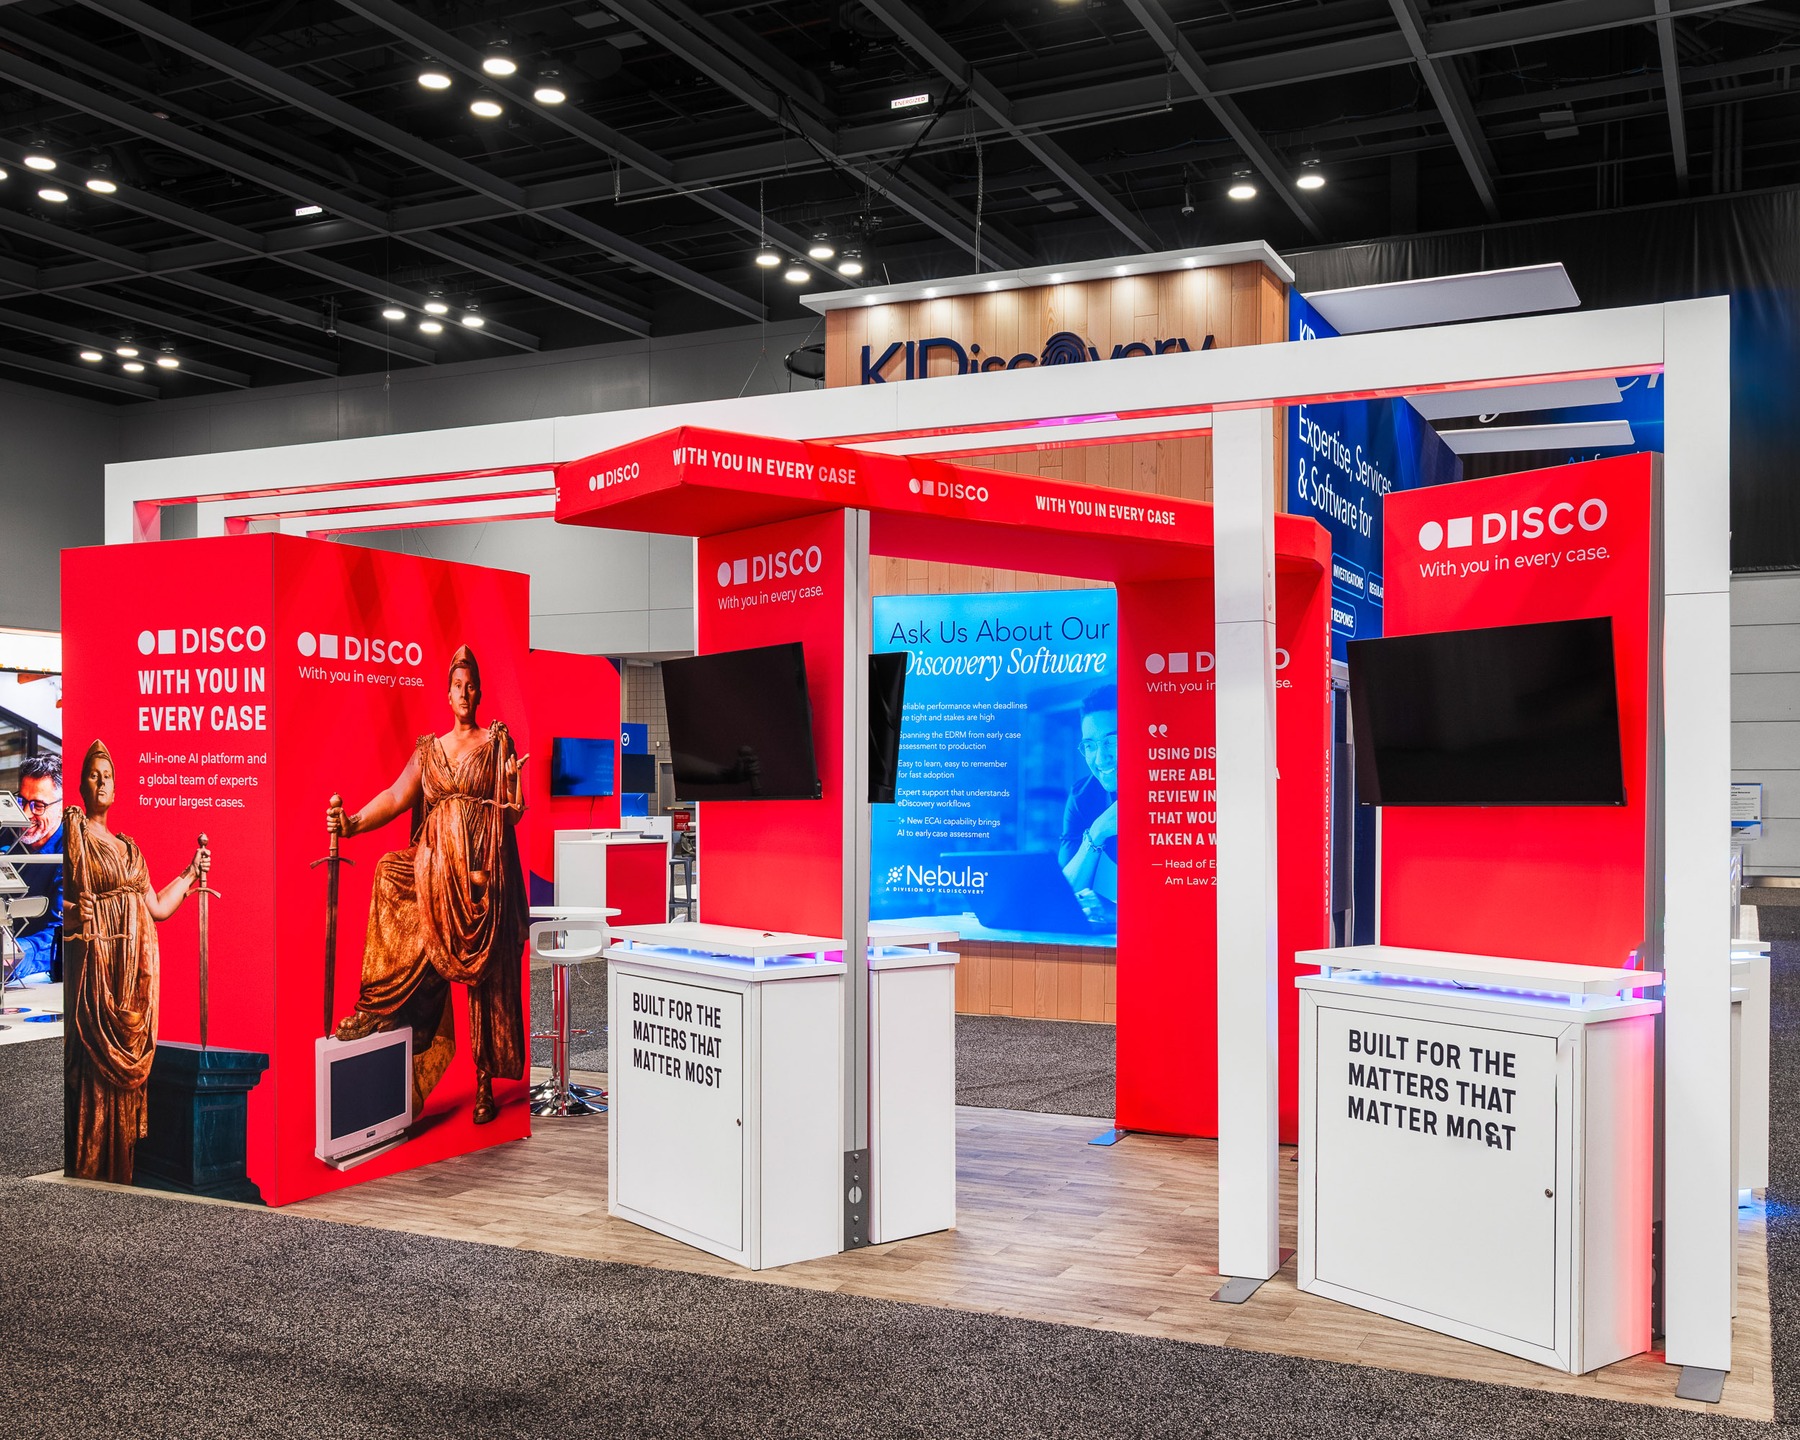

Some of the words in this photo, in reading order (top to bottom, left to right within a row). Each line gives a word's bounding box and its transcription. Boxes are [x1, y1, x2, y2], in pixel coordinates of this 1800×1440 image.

[1299, 404, 1353, 482] Expertise,
[1355, 445, 1392, 496] Services
[606, 462, 639, 487] DISCO
[672, 447, 708, 466] WITH
[711, 451, 743, 471] YOU
[747, 456, 762, 474] IN
[766, 459, 814, 480] EVERY
[818, 466, 856, 485] CASE
[937, 482, 989, 503] DISCO
[1298, 457, 1308, 501] &
[1311, 466, 1357, 530] Software
[1359, 496, 1372, 539] for
[1035, 495, 1066, 514] WITH
[1068, 499, 1092, 516] YOU
[1094, 502, 1107, 517] IN
[1109, 504, 1145, 522] EVERY
[1147, 509, 1176, 526] CASE
[1482, 498, 1608, 544] DISCO
[752, 545, 822, 582] DISCO
[1419, 560, 1456, 578] With
[1460, 560, 1490, 578] you
[1494, 554, 1510, 571] in
[1514, 551, 1562, 568] every
[1566, 546, 1611, 563] case.
[1333, 564, 1364, 590] INVESTIGATIONS
[718, 595, 739, 610] With
[741, 595, 758, 610] you
[760, 591, 769, 604] in
[770, 589, 797, 603] every
[799, 585, 824, 598] case.
[1334, 609, 1354, 628] RESPONSE
[182, 625, 266, 654] DISCO
[889, 620, 931, 644] Ask
[940, 621, 968, 644] Us
[976, 618, 1053, 643] About
[1061, 616, 1110, 640] Our
[345, 635, 423, 666] DISCO
[1007, 646, 1107, 674] Software
[138, 669, 190, 695] WITH
[195, 668, 238, 694] YOU
[244, 667, 265, 693] IN
[298, 665, 327, 680] With
[329, 671, 350, 683] you
[353, 670, 364, 683] in
[366, 674, 396, 687] every
[398, 676, 424, 687] case.
[1146, 681, 1177, 693] With
[1179, 682, 1203, 694] you
[1276, 679, 1293, 689] se.
[902, 702, 925, 710] eliable
[927, 702, 971, 711] performance
[972, 702, 991, 710] when
[993, 701, 1028, 710] deadlines
[139, 706, 205, 731] EVERY
[210, 705, 267, 731] CASE
[911, 714, 927, 723] tight
[928, 713, 942, 721] and
[943, 713, 965, 721] stakes
[979, 713, 995, 723] high
[899, 742, 937, 750] assessment
[948, 742, 986, 751] production
[932, 731, 943, 739] the
[944, 731, 967, 739] EDRM
[968, 731, 985, 739] from
[986, 731, 1003, 741] early
[139, 752, 186, 764] All-in-one
[188, 753, 199, 764] AI
[201, 752, 244, 766] platform
[247, 753, 267, 764] and
[1148, 747, 1190, 760] USING
[898, 760, 913, 769] Easy
[924, 760, 942, 768] learn,
[944, 761, 960, 769] easy
[970, 760, 1008, 768] remember
[1148, 769, 1186, 781] WERE
[139, 776, 145, 785] a
[147, 773, 178, 787] global
[179, 775, 205, 786] team
[207, 774, 218, 786] of
[220, 775, 258, 788] experts
[909, 771, 921, 779] fast
[923, 771, 954, 780] adoption
[139, 794, 152, 806] for
[154, 796, 176, 808] your
[179, 795, 213, 809] largest
[215, 798, 245, 808] cases.
[897, 788, 921, 797] Expert
[922, 789, 950, 798] support
[966, 789, 1010, 797] understands
[1148, 790, 1199, 803] REVIEW
[897, 800, 935, 809] eDiscovery
[924, 817, 941, 825] ECAi
[943, 817, 977, 827] capability
[978, 819, 1000, 828] brings
[1148, 811, 1183, 824] THAT
[915, 829, 932, 838] early
[1149, 833, 1192, 845] TAKEN
[1196, 833, 1205, 845] A
[1165, 859, 1193, 868] Head
[1195, 859, 1207, 868] of
[1165, 877, 1183, 885] Am
[1187, 876, 1208, 885] Law
[633, 992, 665, 1017] BUILT
[669, 999, 693, 1023] FOR
[697, 1004, 721, 1029] THE
[633, 1020, 686, 1050] MATTERS
[690, 1032, 722, 1059] THAT
[1349, 1029, 1409, 1060] BUILT
[1417, 1039, 1461, 1069] FOR
[1469, 1047, 1516, 1079] THE
[633, 1048, 681, 1079] MATTER
[685, 1060, 722, 1089] MOST
[1348, 1062, 1449, 1102] MATTERS
[1456, 1080, 1516, 1114] THAT
[1348, 1095, 1438, 1136] MATTER
